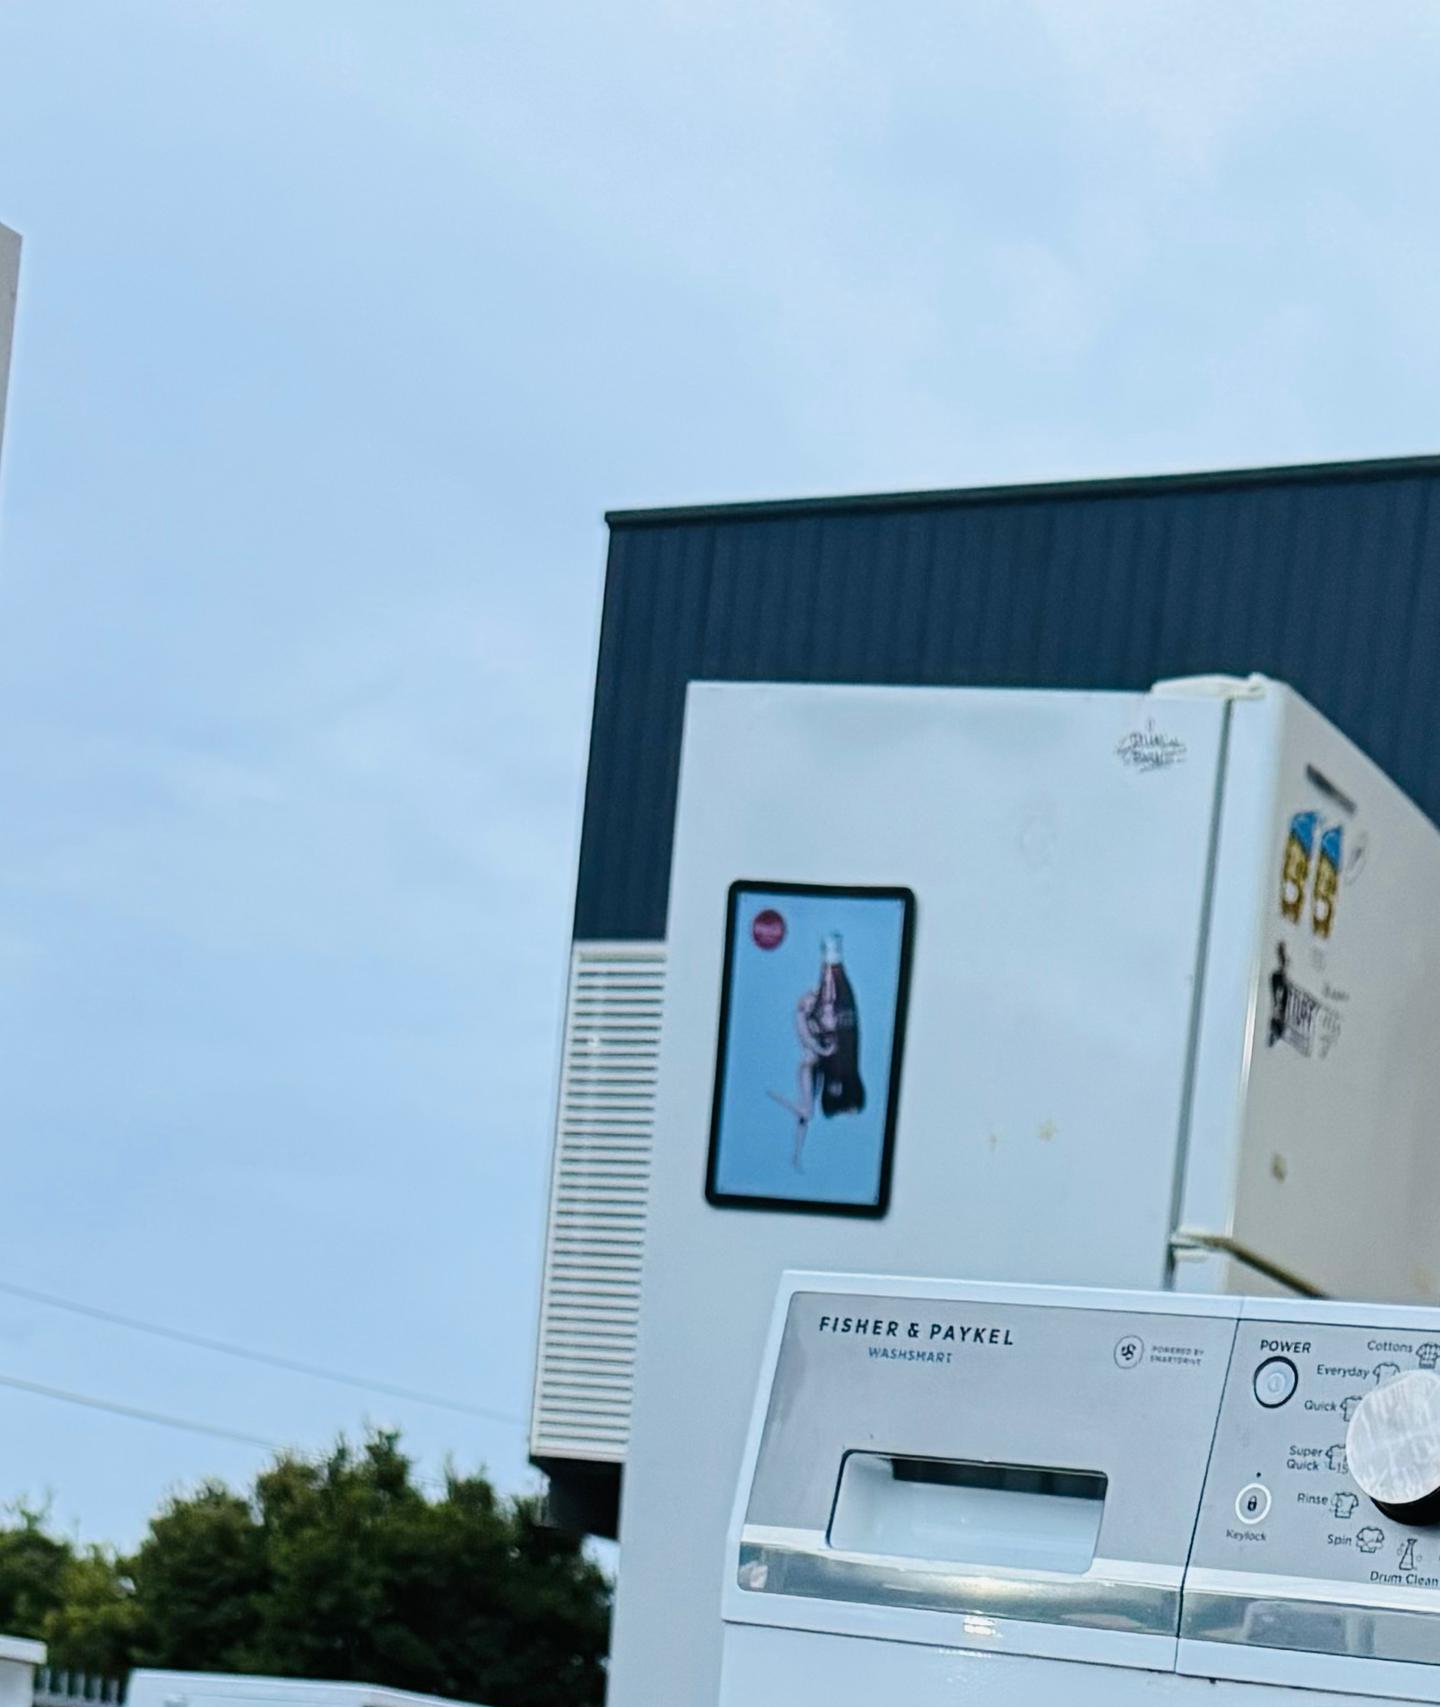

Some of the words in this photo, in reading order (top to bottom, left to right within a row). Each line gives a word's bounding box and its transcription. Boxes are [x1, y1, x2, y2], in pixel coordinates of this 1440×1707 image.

[819, 1316, 899, 1338] FISHER
[907, 1322, 920, 1339] &
[929, 1324, 1015, 1346] PAYKEL
[1260, 1339, 1312, 1354] POWER
[1367, 1340, 1413, 1354] Cottons
[868, 1347, 953, 1364] WASHSMART
[1317, 1364, 1371, 1379] Everyday
[1304, 1400, 1337, 1412] Quick
[1289, 1445, 1324, 1459] Super
[1286, 1459, 1320, 1472] Quick
[1297, 1492, 1329, 1506] Rinse
[1225, 1528, 1268, 1543] Keylock
[1327, 1532, 1353, 1547] Spin
[1370, 1570, 1402, 1584] Drum
[1405, 1572, 1439, 1588] Clean
